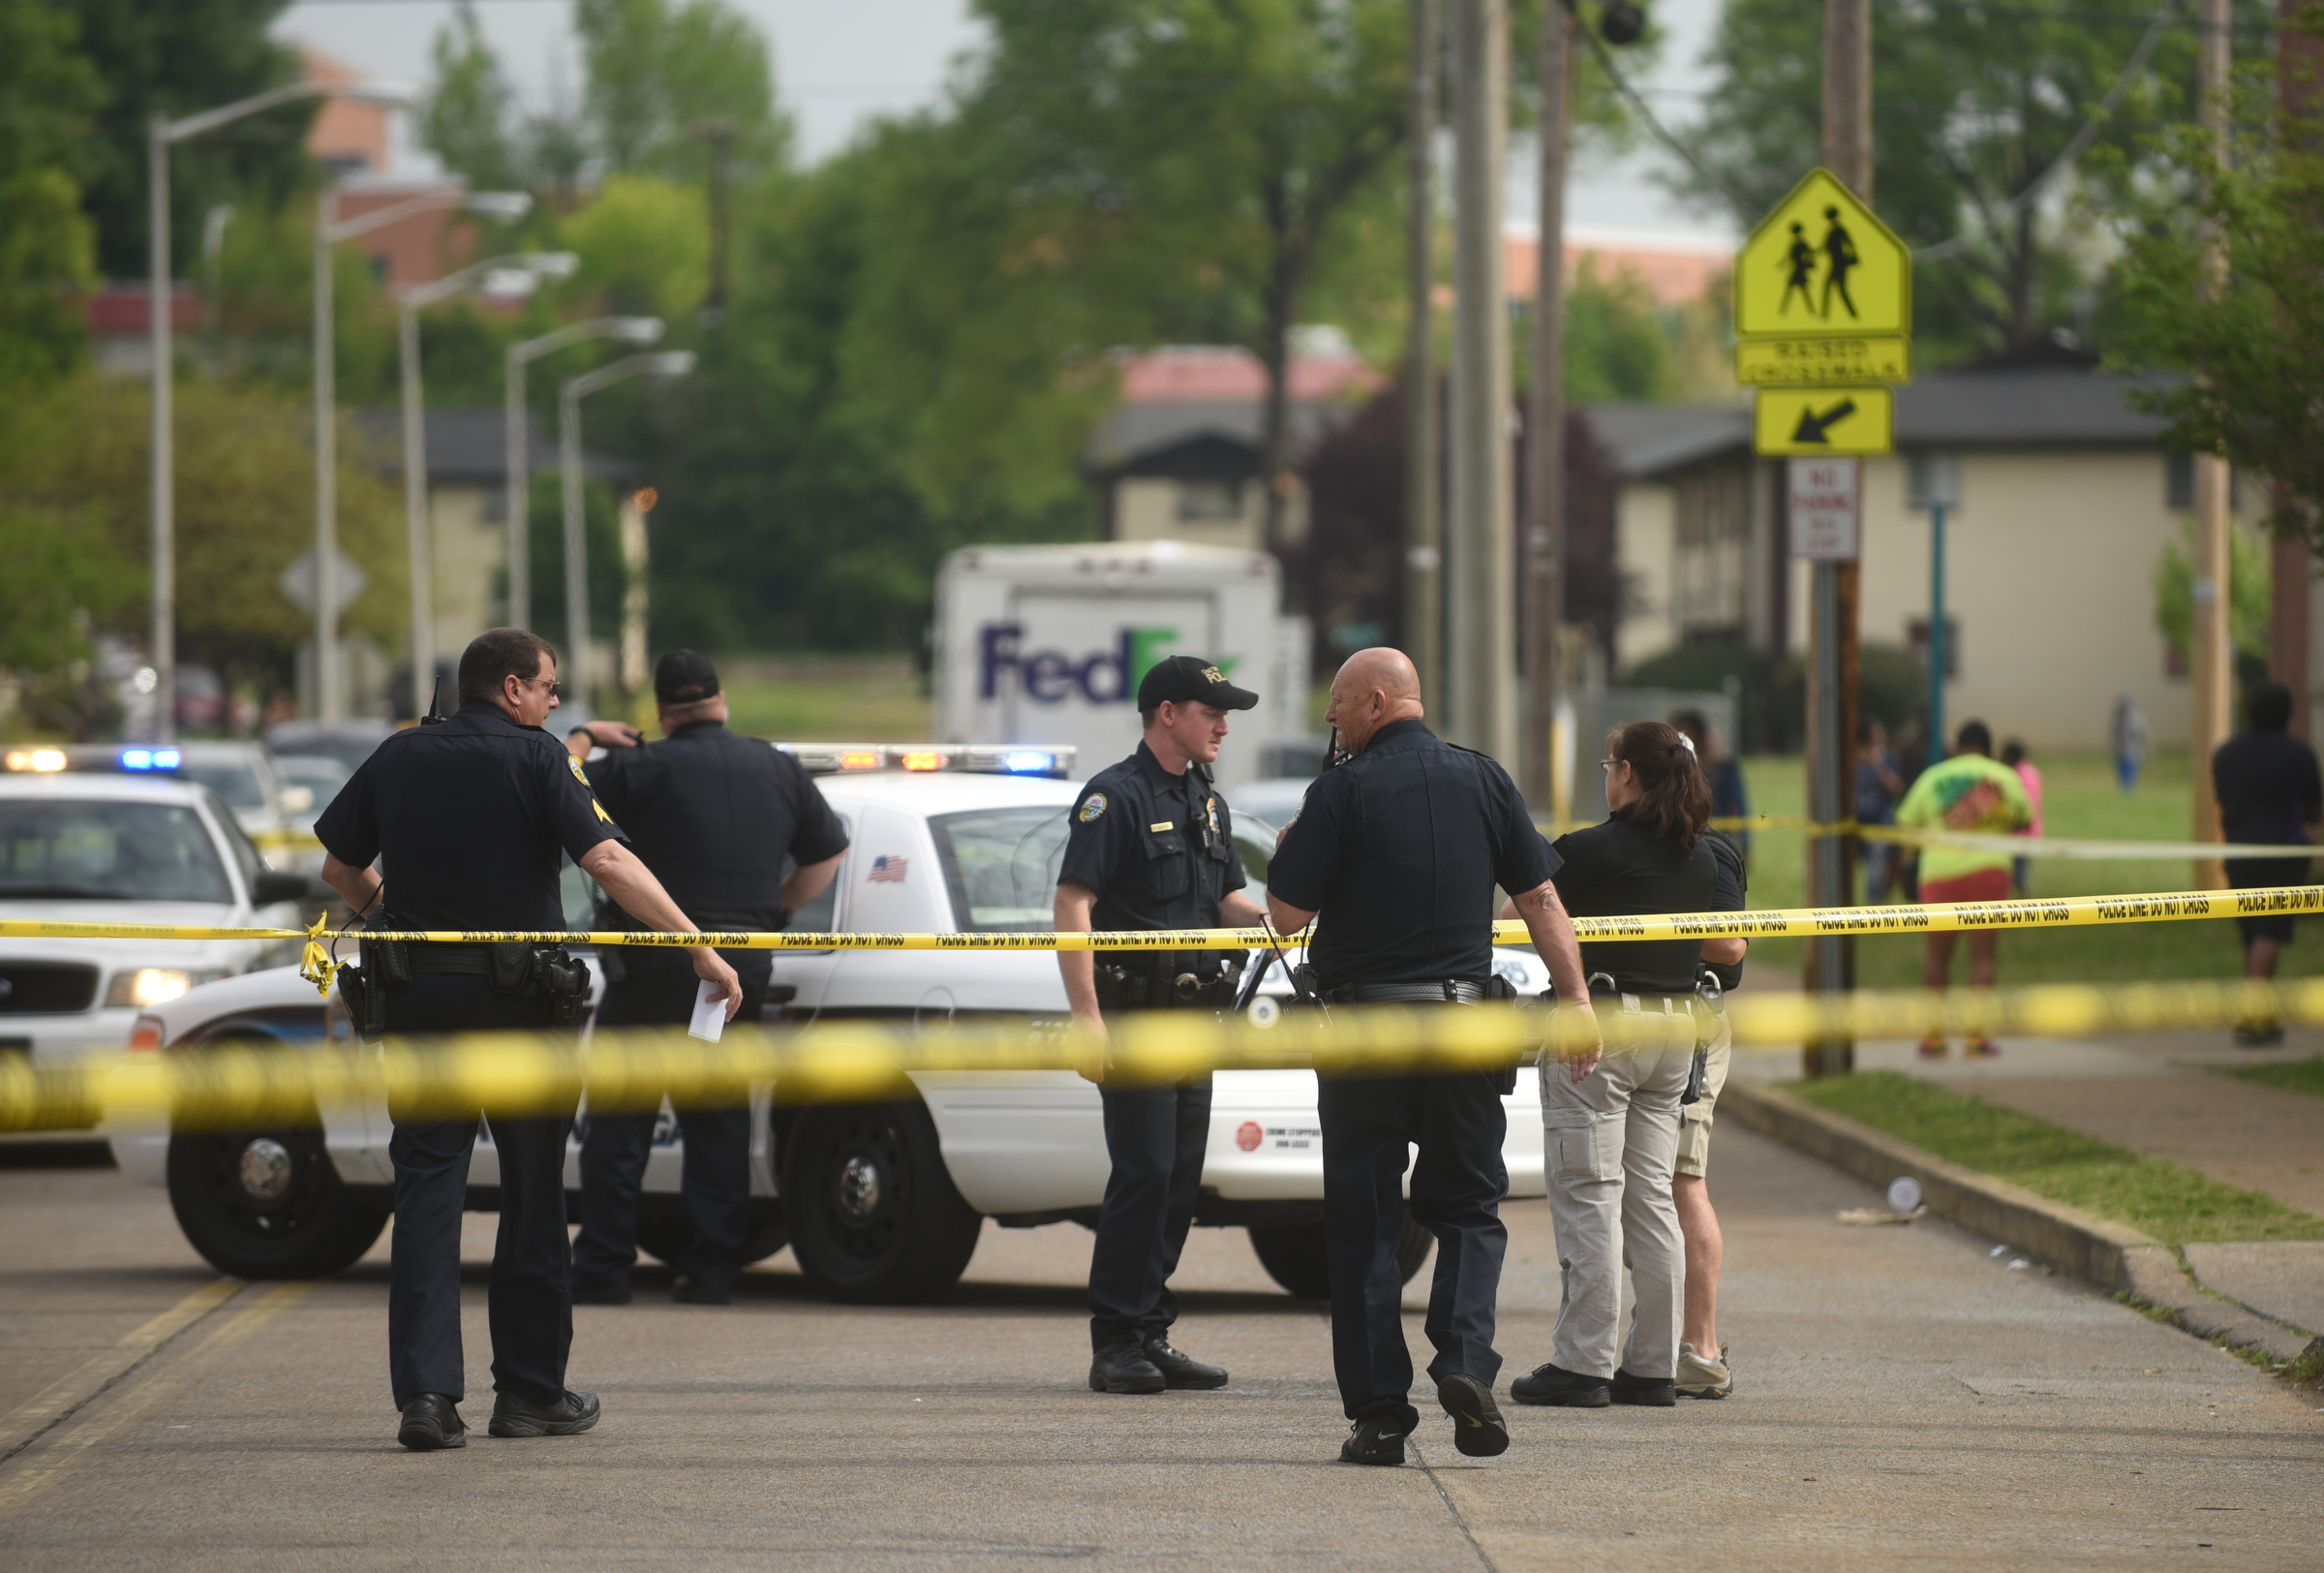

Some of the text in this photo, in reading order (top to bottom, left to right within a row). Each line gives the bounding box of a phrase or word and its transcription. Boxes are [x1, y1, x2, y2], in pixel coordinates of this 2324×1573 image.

[981, 625, 1242, 702] FedE
[2095, 899, 2126, 919] POLICE
[2149, 897, 2162, 916] DO
[2162, 896, 2180, 915] NOT
[2182, 894, 2209, 914] CROSS
[2236, 892, 2266, 912] POLICE
[2289, 889, 2303, 909] DO
[2304, 888, 2320, 908] NOT
[1669, 916, 1703, 934] POLICE
[1724, 914, 1739, 933] DO
[1738, 914, 1758, 932] NOT
[1758, 912, 1787, 931] CROSS
[1813, 911, 1845, 930] POLICE
[1865, 910, 1881, 928] DO
[1880, 909, 1899, 927] NOT
[1899, 908, 1929, 927] CROSS
[1954, 906, 1986, 925] POLICE
[2007, 904, 2022, 922] DO
[2022, 903, 2039, 922] NOT
[2040, 901, 2069, 921] CROSS
[1086, 932, 1118, 945] POLICE
[1143, 931, 1156, 945] DO
[1158, 931, 1176, 945] NOT
[1177, 930, 1207, 944] CROSS
[1582, 919, 1596, 937] DO
[1597, 918, 1614, 936] NOT
[1614, 917, 1644, 936] CROSS
[623, 932, 655, 943] POLICE
[682, 932, 696, 944] DO
[697, 932, 716, 944] NOT
[719, 932, 749, 945] CROSS
[780, 933, 812, 945] POLICE
[839, 933, 852, 945] DO
[854, 933, 872, 945] NOT
[874, 933, 904, 946] CROSS
[934, 933, 966, 946] POLICE
[992, 933, 1006, 946] DO
[1007, 933, 1024, 946] NOT
[1026, 933, 1057, 946] CROSS
